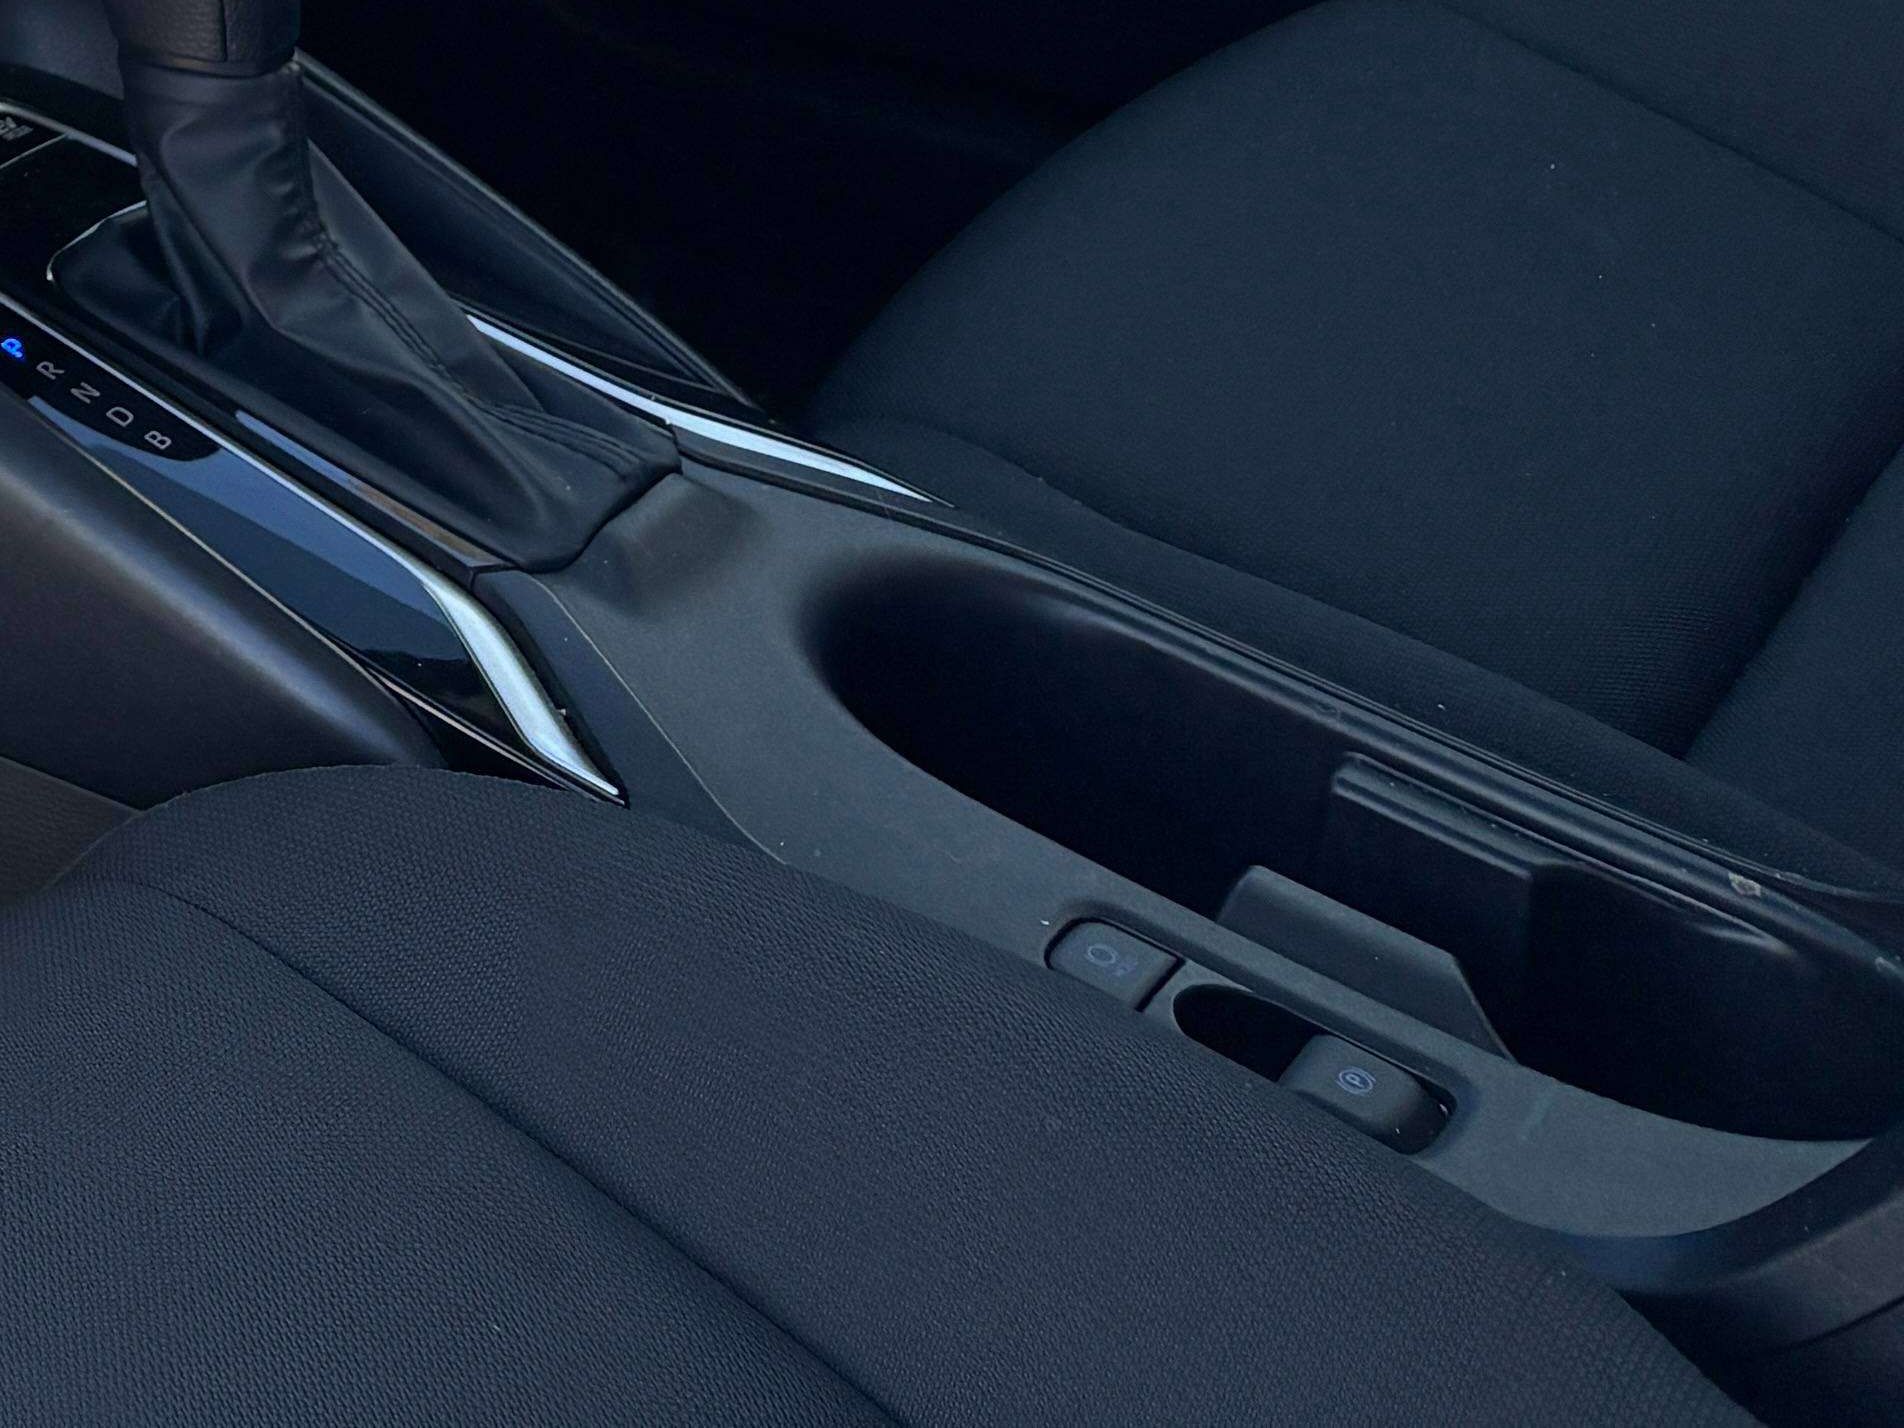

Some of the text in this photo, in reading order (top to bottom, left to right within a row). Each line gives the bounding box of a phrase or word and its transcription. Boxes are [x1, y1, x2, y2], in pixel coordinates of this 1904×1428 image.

[0, 337, 24, 359] P
[35, 360, 66, 381] R
[69, 380, 102, 405] N
[105, 405, 135, 428] D
[143, 429, 173, 451] B
